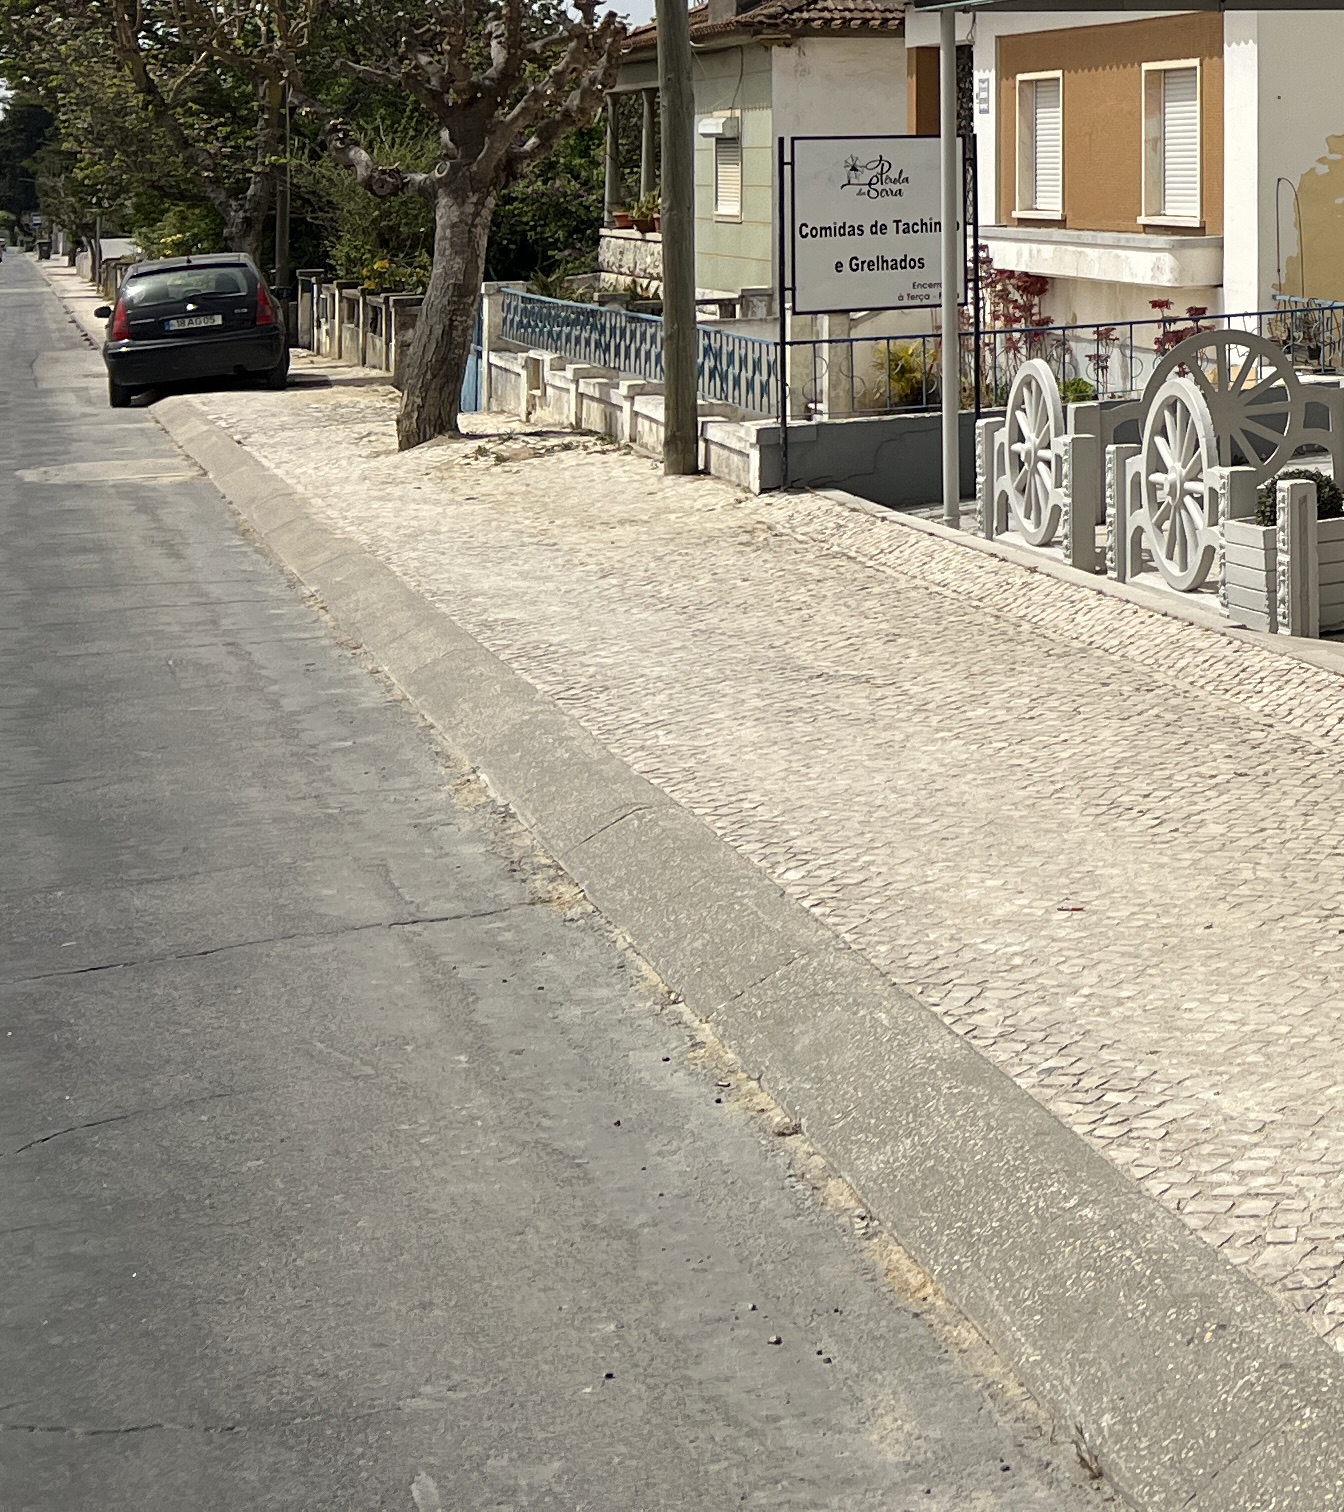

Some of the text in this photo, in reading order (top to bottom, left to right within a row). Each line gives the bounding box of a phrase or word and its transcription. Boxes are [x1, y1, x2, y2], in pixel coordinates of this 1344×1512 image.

[798, 217, 960, 239] Comidas de Tachin
[834, 254, 926, 273] e Grelhados
[906, 292, 931, 302] Terça
